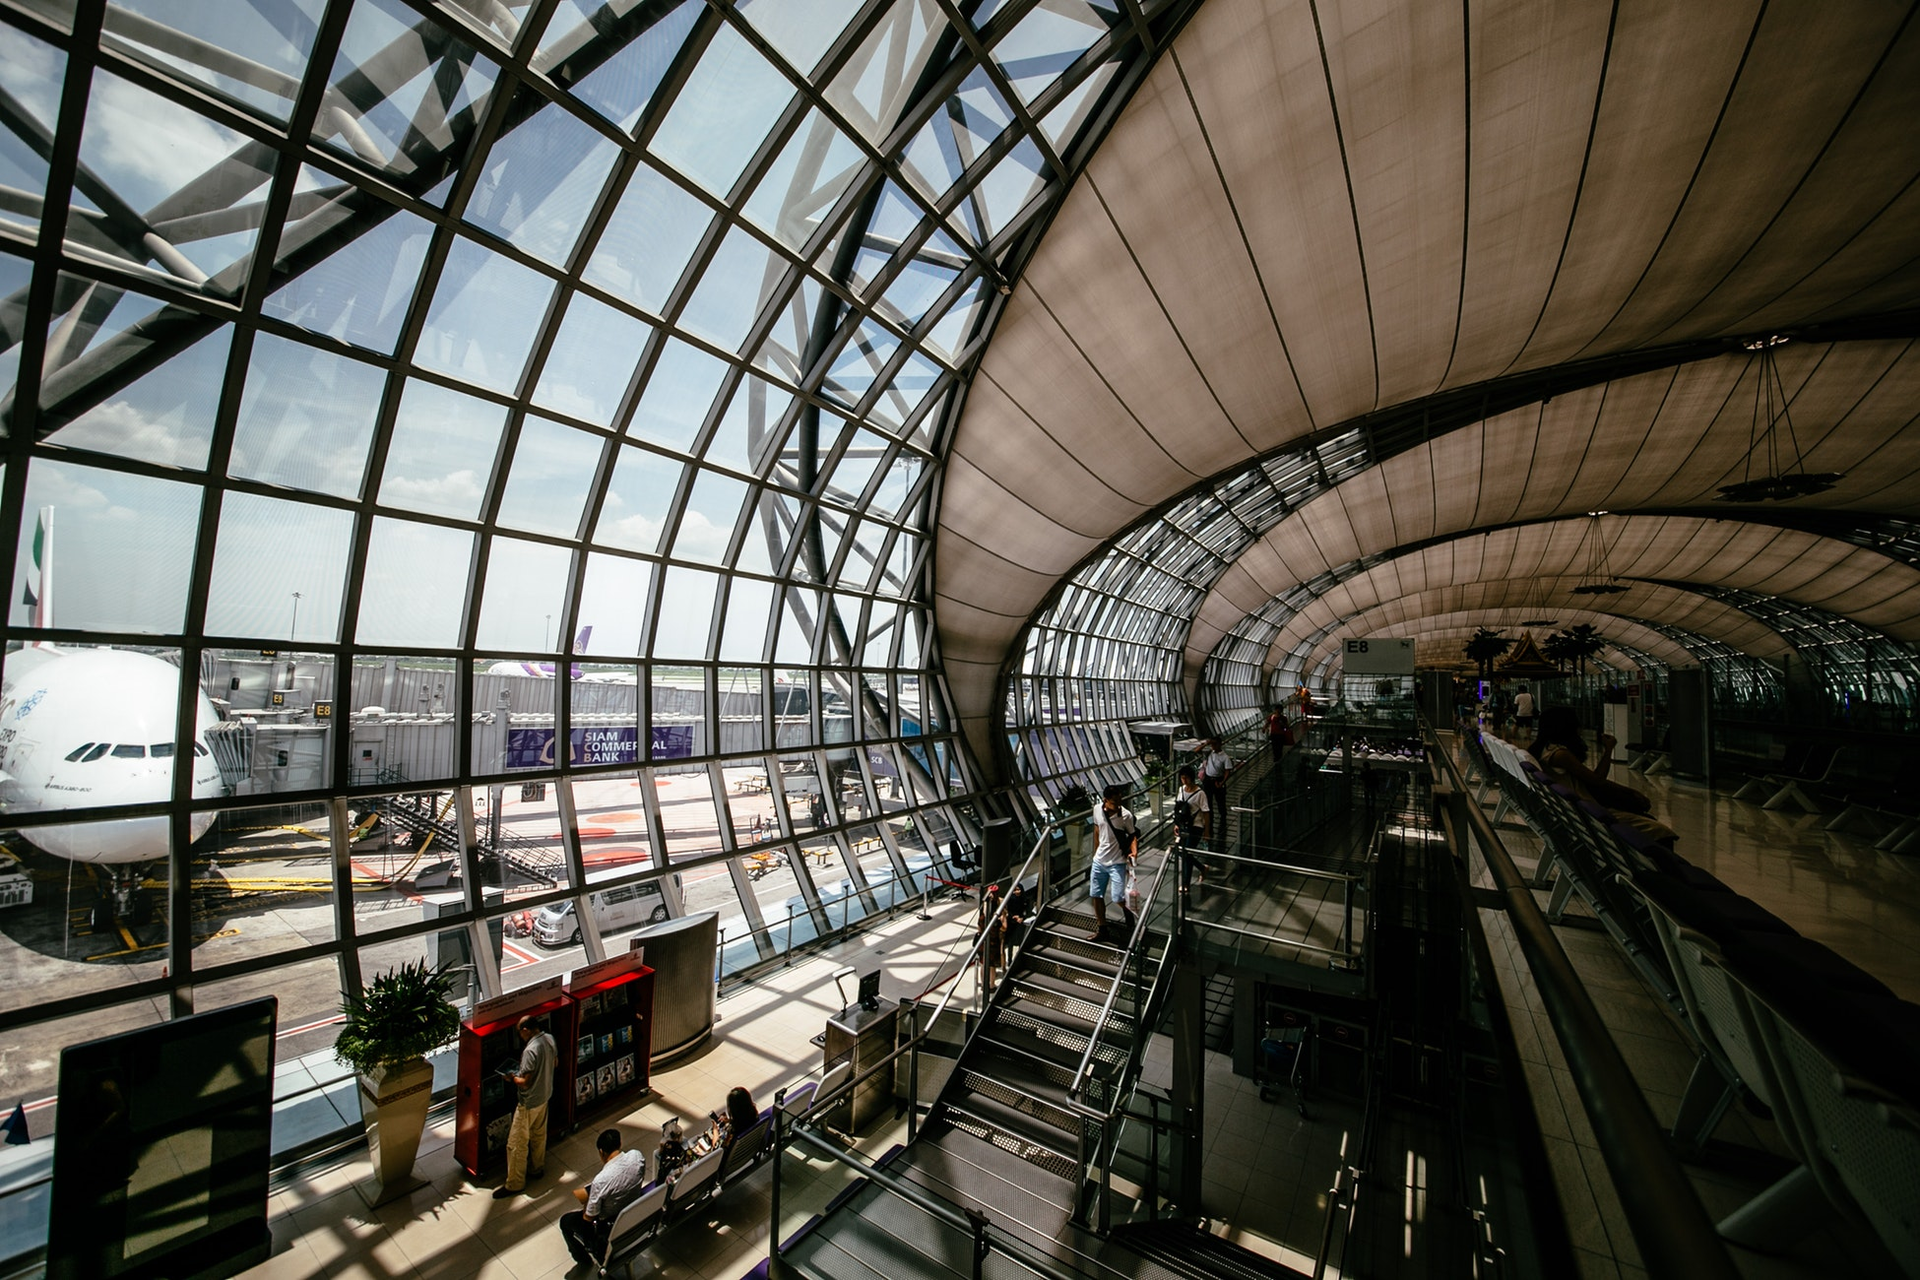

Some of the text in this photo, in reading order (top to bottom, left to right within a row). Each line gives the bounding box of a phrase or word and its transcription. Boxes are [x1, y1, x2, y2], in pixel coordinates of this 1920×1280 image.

[1347, 640, 1369, 653] E8
[316, 705, 331, 716] E8
[584, 731, 618, 742] SIAM
[584, 753, 619, 763] BANK
[870, 756, 883, 764] SCB
